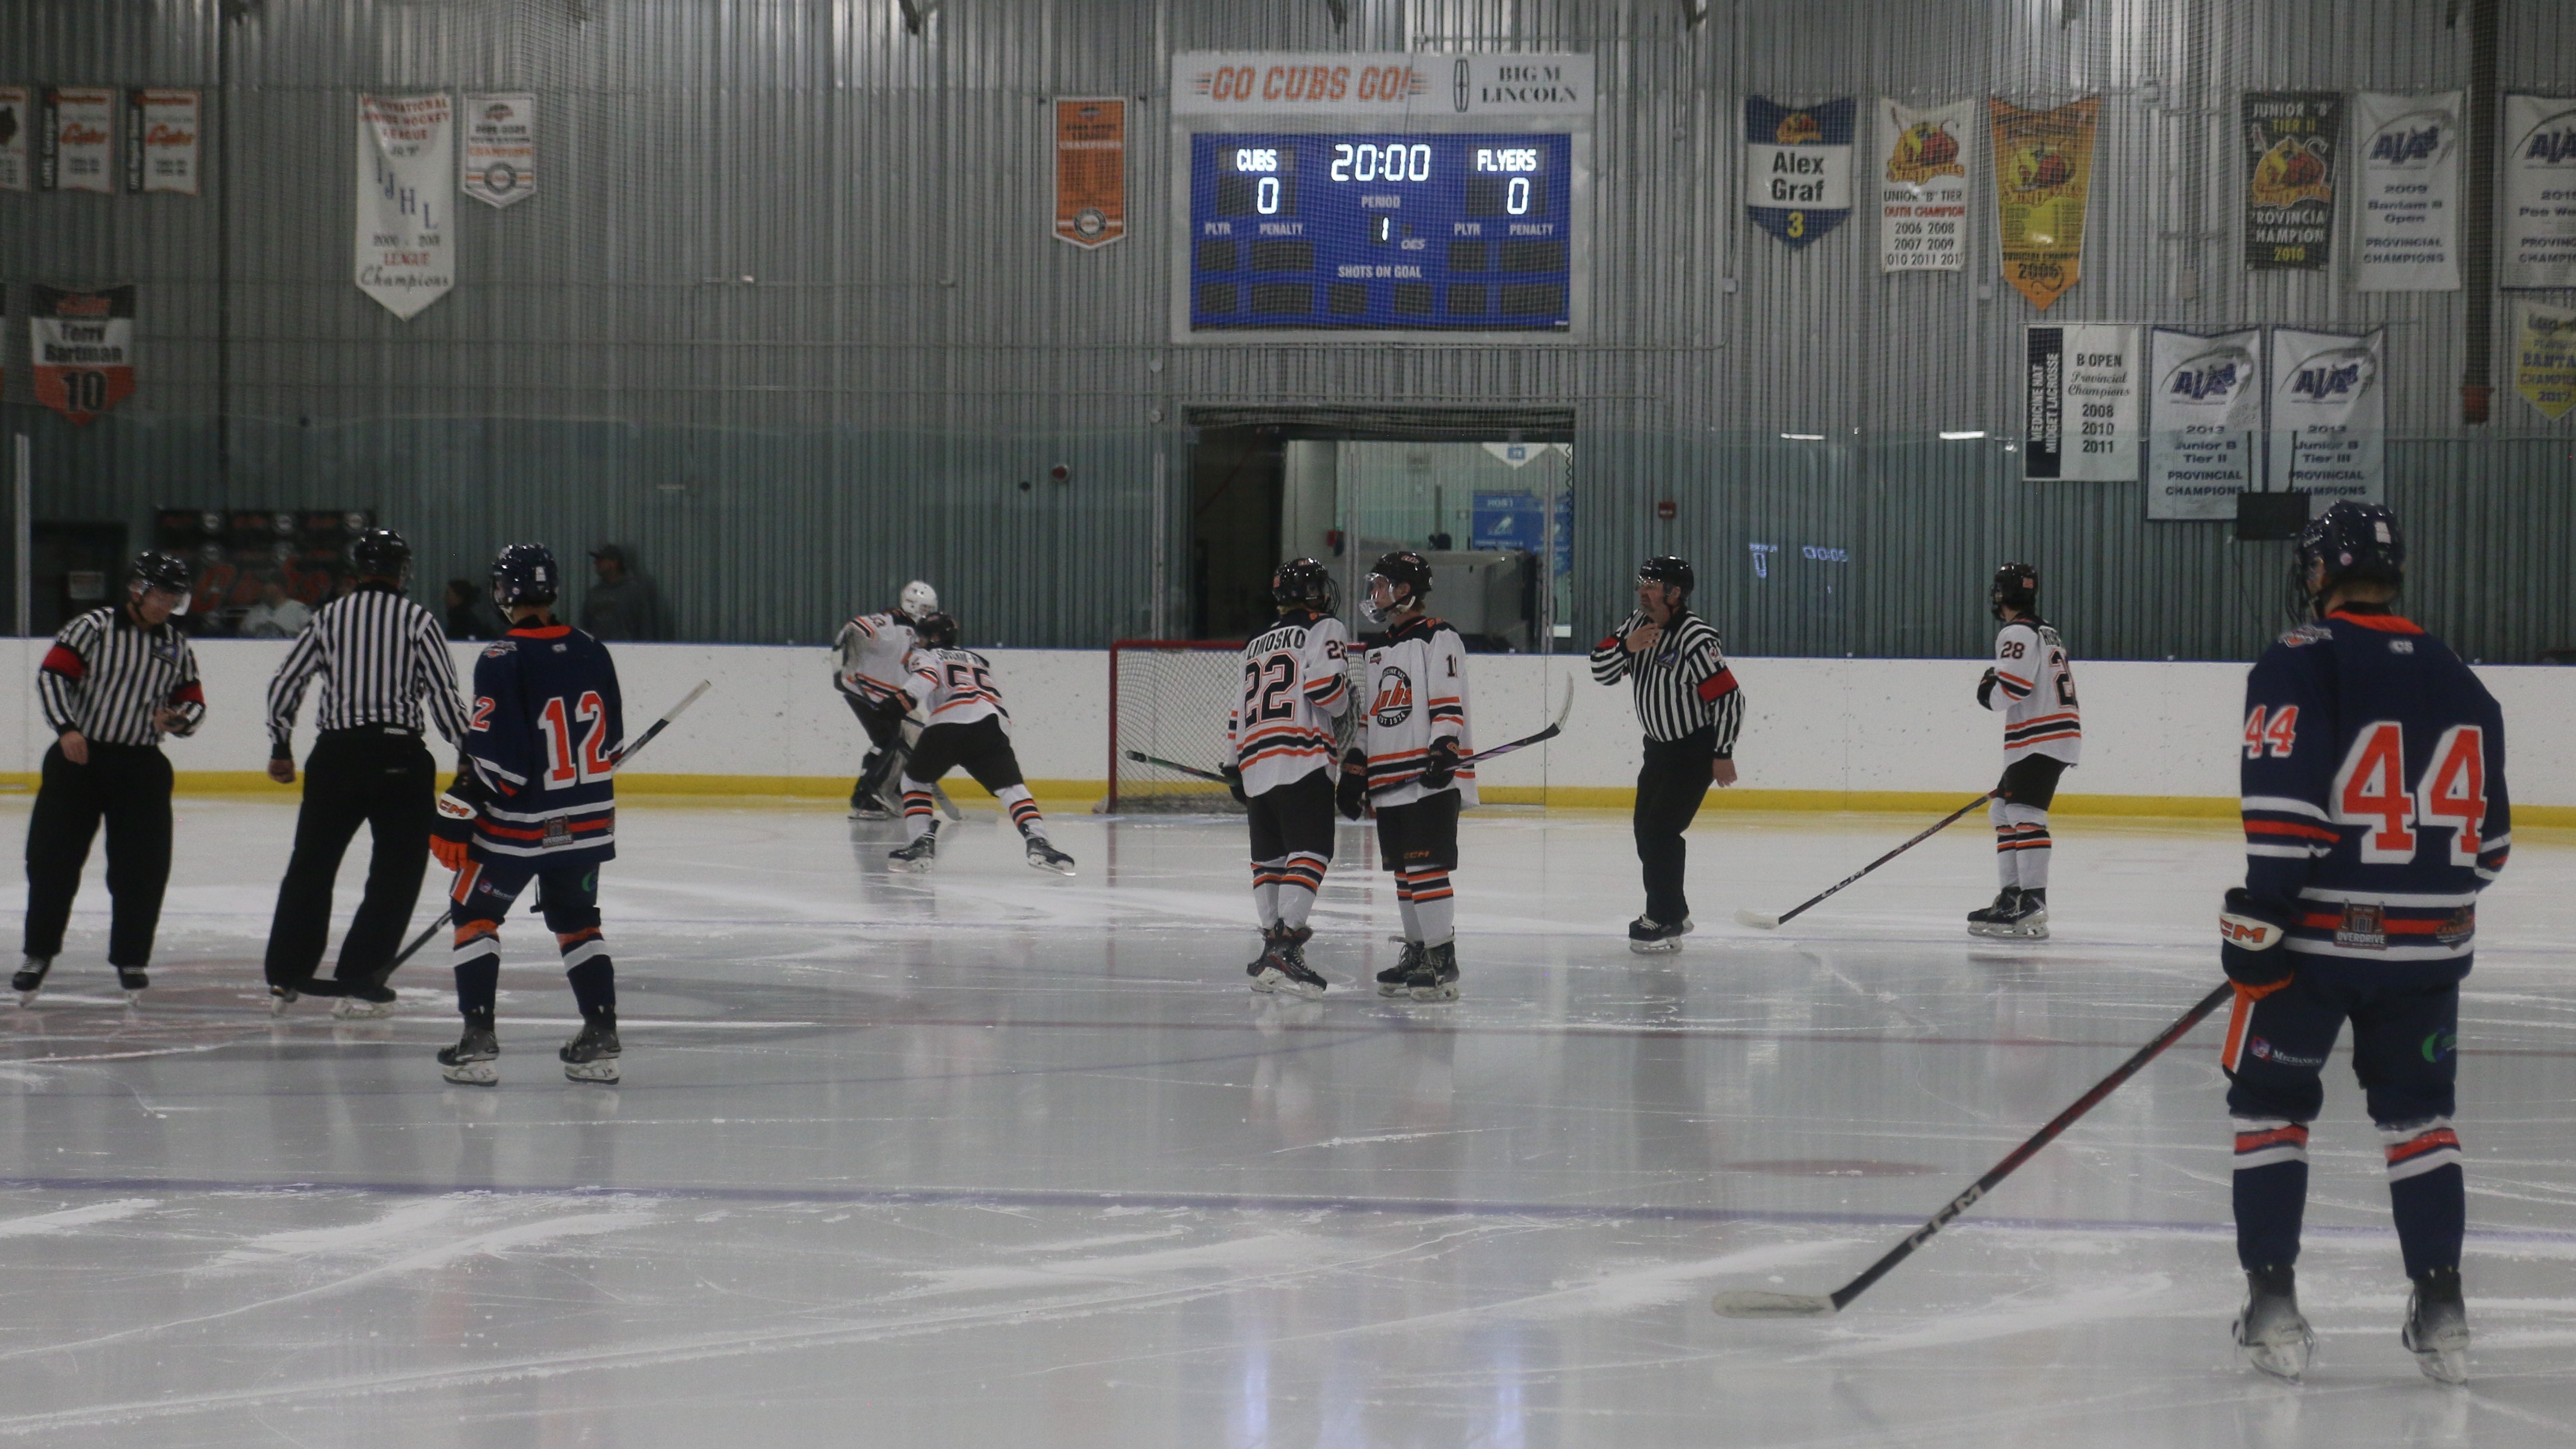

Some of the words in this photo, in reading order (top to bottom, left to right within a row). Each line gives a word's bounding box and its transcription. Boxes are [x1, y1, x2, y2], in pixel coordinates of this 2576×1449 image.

[1498, 66, 1538, 82] BIG
[1540, 66, 1561, 82] M
[1211, 66, 1256, 101] GO
[1263, 66, 1351, 101] CUBS
[1357, 66, 1412, 101] GO!
[1481, 86, 1578, 103] LINCOLN
[361, 97, 448, 113] INRNATIONAL
[2252, 102, 2304, 118] JUNIOR
[404, 112, 449, 126] HOCKEY
[2273, 119, 2301, 132] TIER
[383, 130, 428, 141] LEAGUE
[1236, 148, 1277, 172] CUBS
[1330, 143, 1432, 182] 20:00
[1476, 148, 1537, 172] FLYERS
[1773, 151, 1825, 175] Alex
[1257, 176, 1280, 215] 0
[1506, 176, 1531, 215] 0
[1771, 178, 1825, 202] Graf
[1883, 190, 1918, 203] UNIOR
[1941, 190, 1962, 201] TIER
[2384, 184, 2428, 195] 2009
[1361, 195, 1401, 209] PERIOD
[2367, 200, 2428, 211] Bantam
[1884, 205, 1912, 218] OUTH
[2252, 211, 2326, 225] ROVINCIA
[1787, 211, 1804, 238] 3
[2384, 214, 2426, 226] Open
[1205, 223, 1231, 236] PLYR
[1259, 223, 1304, 236] PENALTY
[1381, 217, 1389, 241] 1
[1454, 223, 1481, 236] PLYR
[1509, 223, 1554, 236] PENALTY
[1895, 223, 1921, 234] 2006
[1928, 223, 1954, 234] 2008
[2256, 228, 2324, 243] HAMPION
[1400, 238, 1426, 250] OES
[1894, 238, 1921, 250] 2007
[1927, 238, 1954, 250] 2009
[2365, 238, 2443, 248] PROVINCIAL
[384, 252, 430, 266] LEAGUE
[1886, 254, 1907, 266] 010
[1911, 254, 1936, 266] 2011
[2363, 253, 2445, 264] CHAMPIONS
[361, 265, 449, 291] Champions
[1337, 265, 1373, 279] SHOTS
[1375, 265, 1392, 279] ON
[1394, 265, 1422, 279] GOAL
[2076, 354, 2085, 366] B
[2088, 353, 2122, 367] OPEN
[2523, 352, 2576, 368] BANTA
[2031, 363, 2044, 387] HAT
[2046, 352, 2059, 408] LACROSSE
[2070, 371, 2128, 384] Provincial
[61, 370, 108, 412] 10
[2067, 384, 2131, 401] Champions
[2031, 388, 2044, 442] MEDICINE
[2081, 404, 2114, 418] 2008
[2045, 411, 2058, 454] MIDGET
[2081, 422, 2114, 436] 2010
[2082, 440, 2114, 454] 2011
[2183, 454, 2217, 464] Tier
[2218, 454, 2227, 464] II
[2302, 454, 2335, 464] Tier
[2167, 471, 2242, 481] PROVINCIAL
[2165, 486, 2245, 496] CHAMPIONS
[2293, 486, 2366, 496] HAMPIONS
[1325, 639, 1348, 660] 22
[2000, 640, 2026, 659] 28
[1245, 650, 1299, 732] 22
[469, 696, 496, 732] 2
[2242, 704, 2300, 760] 44
[536, 690, 613, 792] 12
[2328, 719, 2488, 868] 44
[440, 799, 470, 818] CM
[2219, 916, 2268, 944] CM
[2336, 931, 2387, 946] OVERDRIVE
